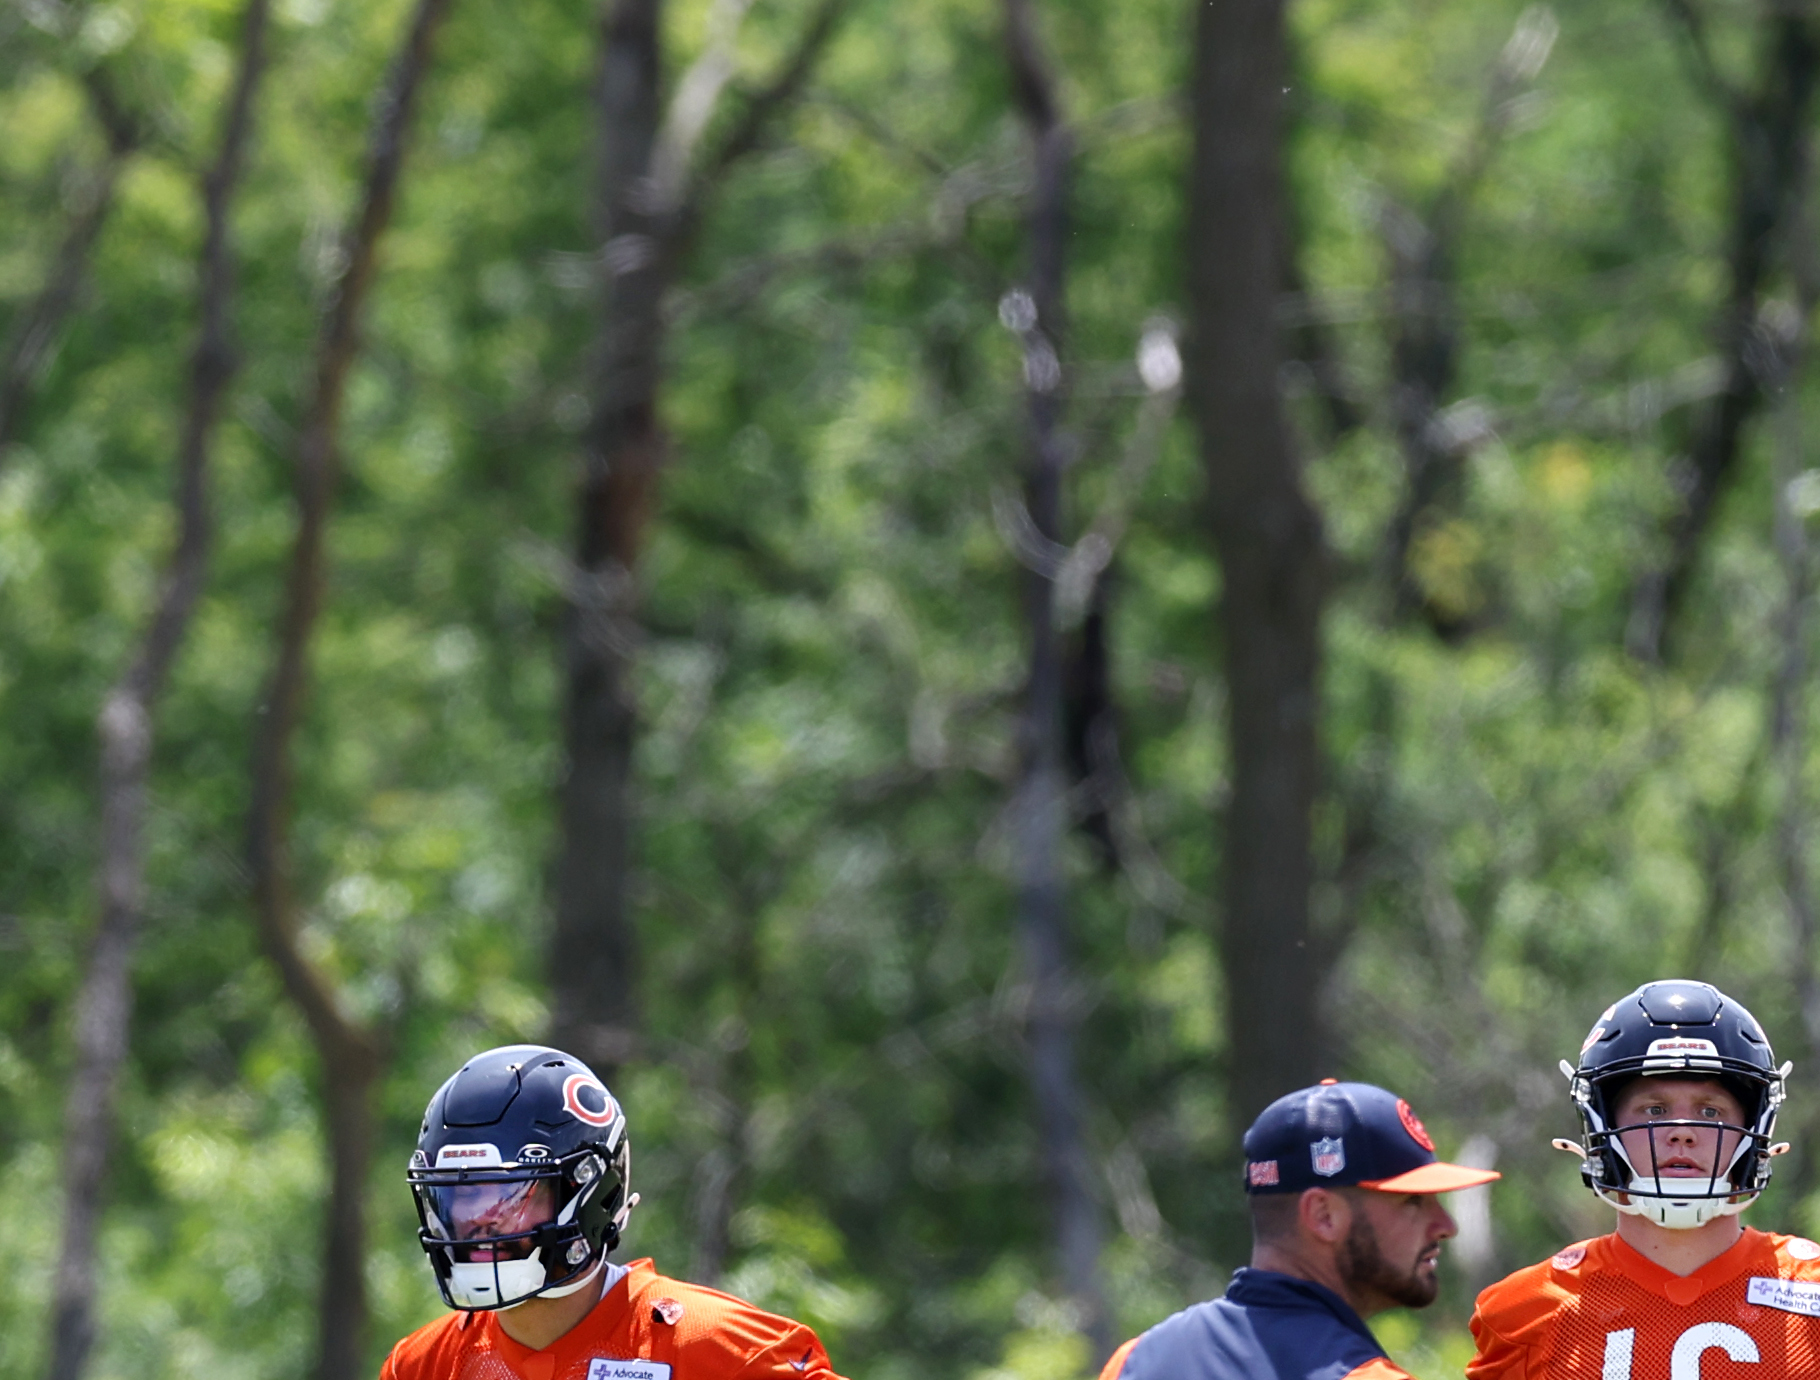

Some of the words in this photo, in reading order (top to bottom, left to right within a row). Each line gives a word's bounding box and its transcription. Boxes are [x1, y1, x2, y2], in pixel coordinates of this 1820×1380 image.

[1657, 1042, 1707, 1051] BEARS
[562, 1073, 616, 1127] C
[443, 1149, 487, 1158] BEARS
[1773, 1295, 1808, 1310] Health
[612, 1368, 654, 1380] Advocate
